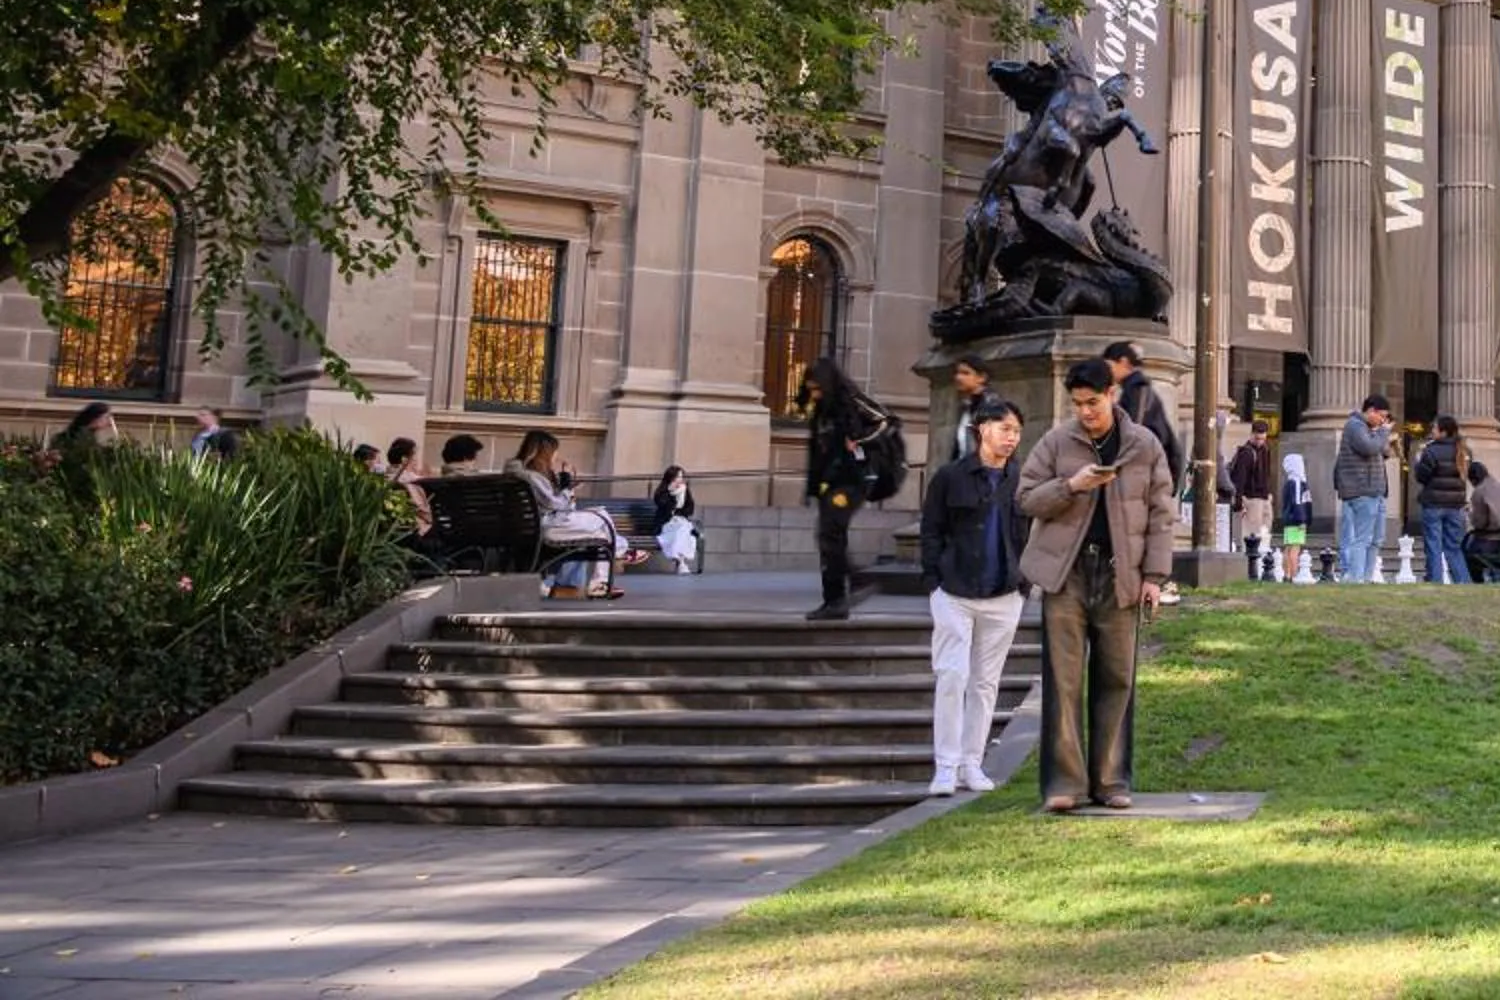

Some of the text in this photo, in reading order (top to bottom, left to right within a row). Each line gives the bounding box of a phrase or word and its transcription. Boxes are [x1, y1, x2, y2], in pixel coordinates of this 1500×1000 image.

[1135, 42, 1145, 70] THE
[1135, 79, 1145, 98] OF
[1385, 7, 1425, 234] WILDE
